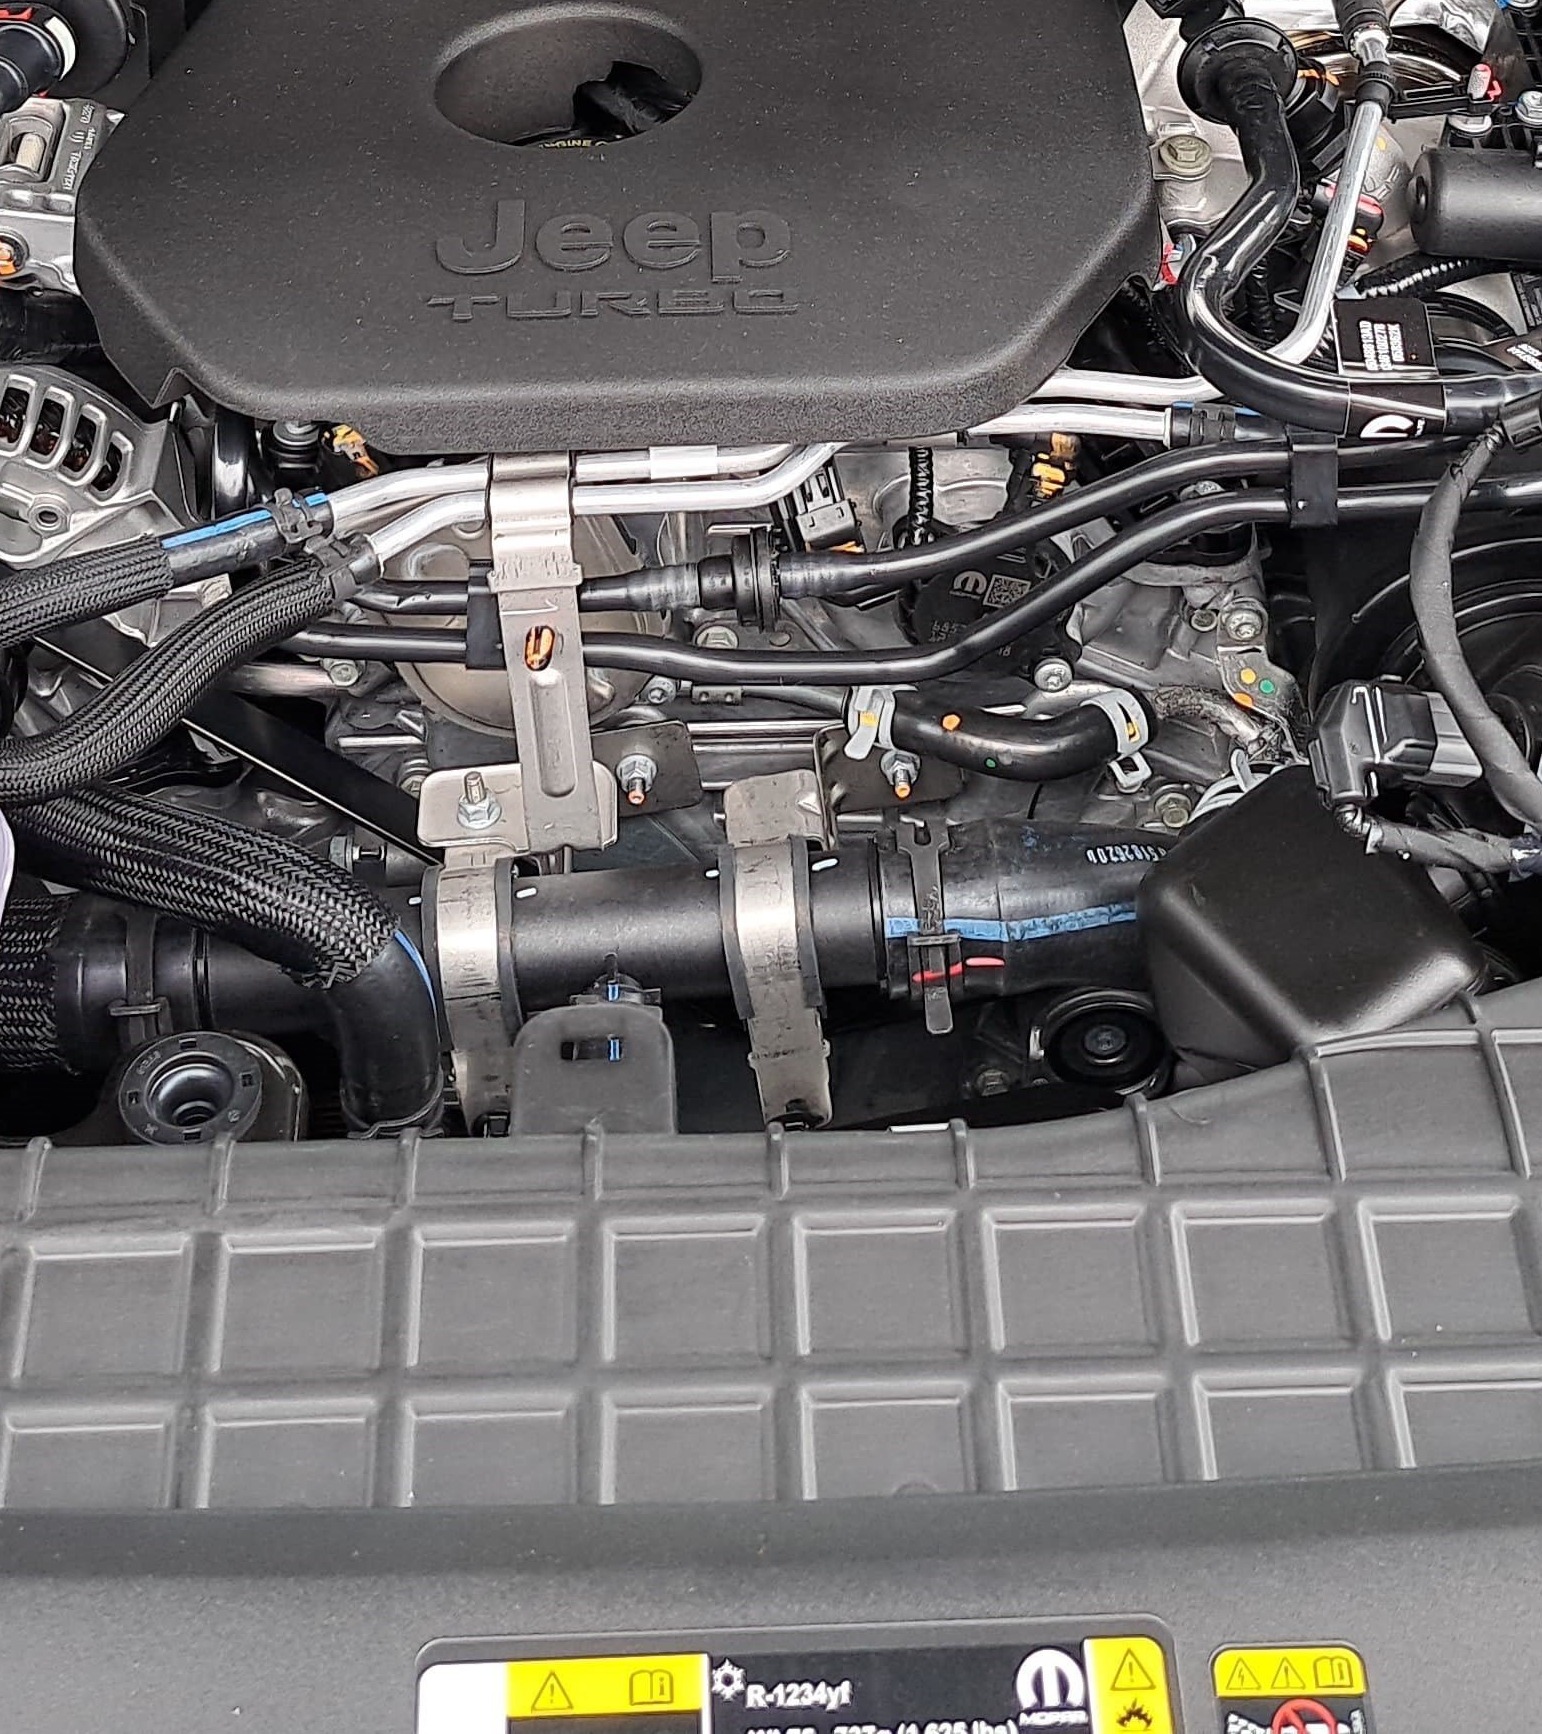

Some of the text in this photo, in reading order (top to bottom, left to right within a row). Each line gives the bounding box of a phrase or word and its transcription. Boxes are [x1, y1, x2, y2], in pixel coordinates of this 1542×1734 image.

[435, 199, 793, 283] Jeep
[426, 288, 800, 322] TURBO
[745, 1680, 852, 1712] R-1234yf
